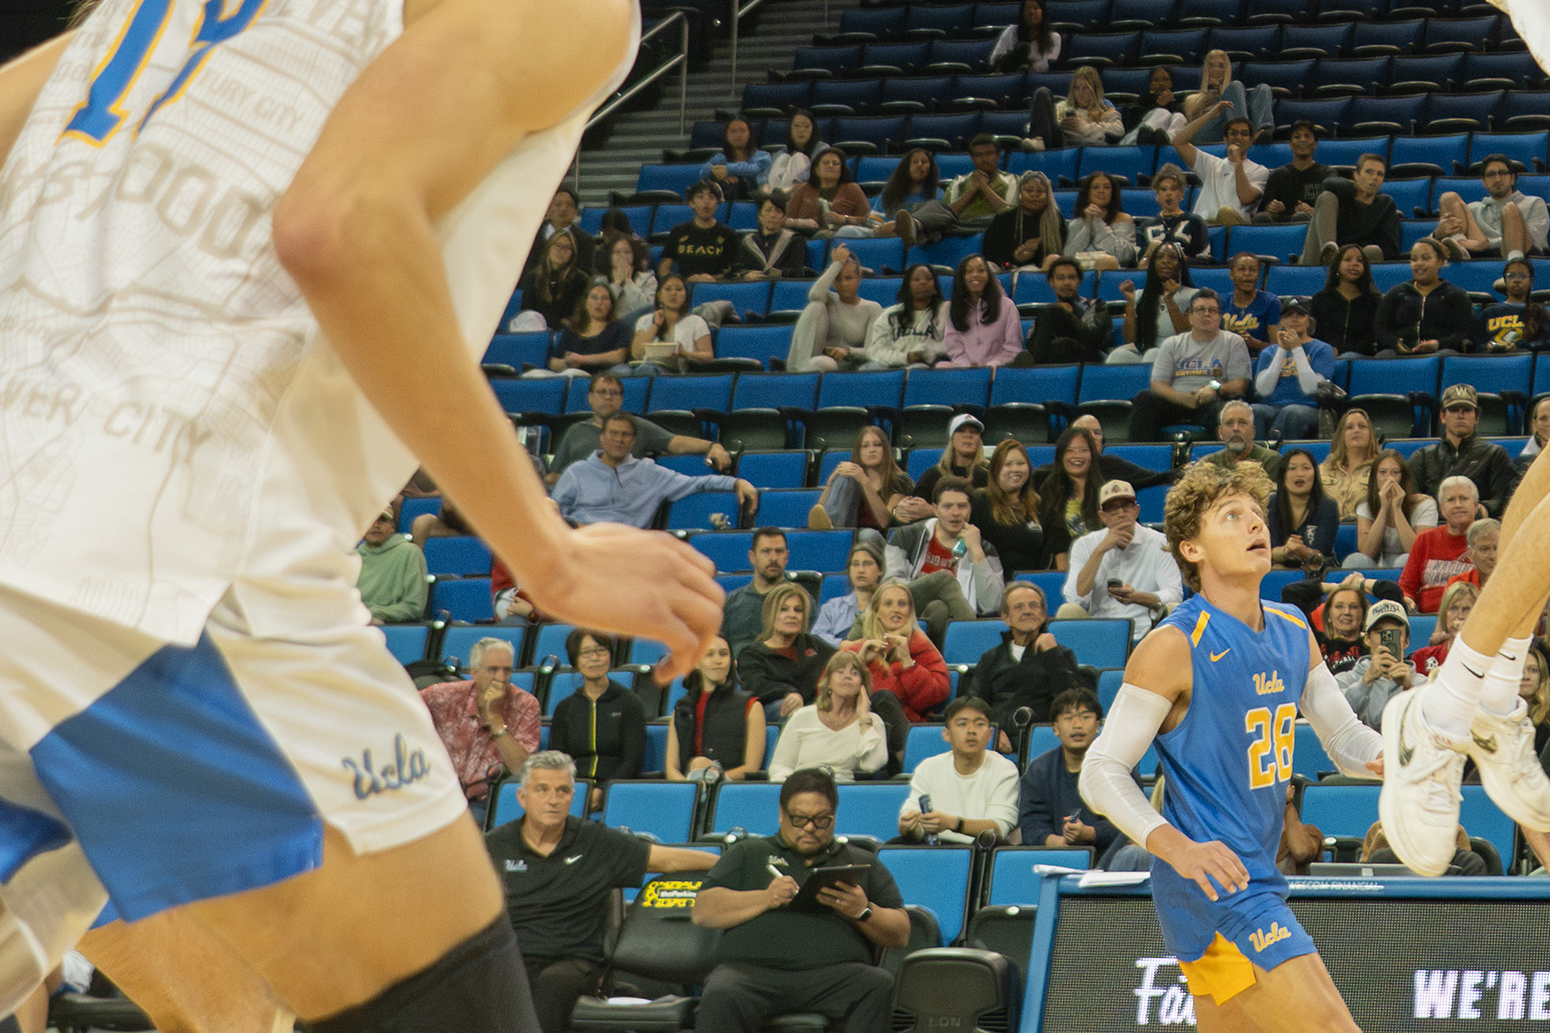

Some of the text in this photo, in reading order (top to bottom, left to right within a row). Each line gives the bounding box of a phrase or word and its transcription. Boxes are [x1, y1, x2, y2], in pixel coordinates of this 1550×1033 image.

[678, 244, 725, 256] BEACH
[1252, 670, 1285, 695] Ucla
[342, 733, 431, 800] Ucla
[1245, 702, 1297, 790] 28
[1249, 921, 1291, 952] Ucla
[1133, 955, 1197, 1026] Fa
